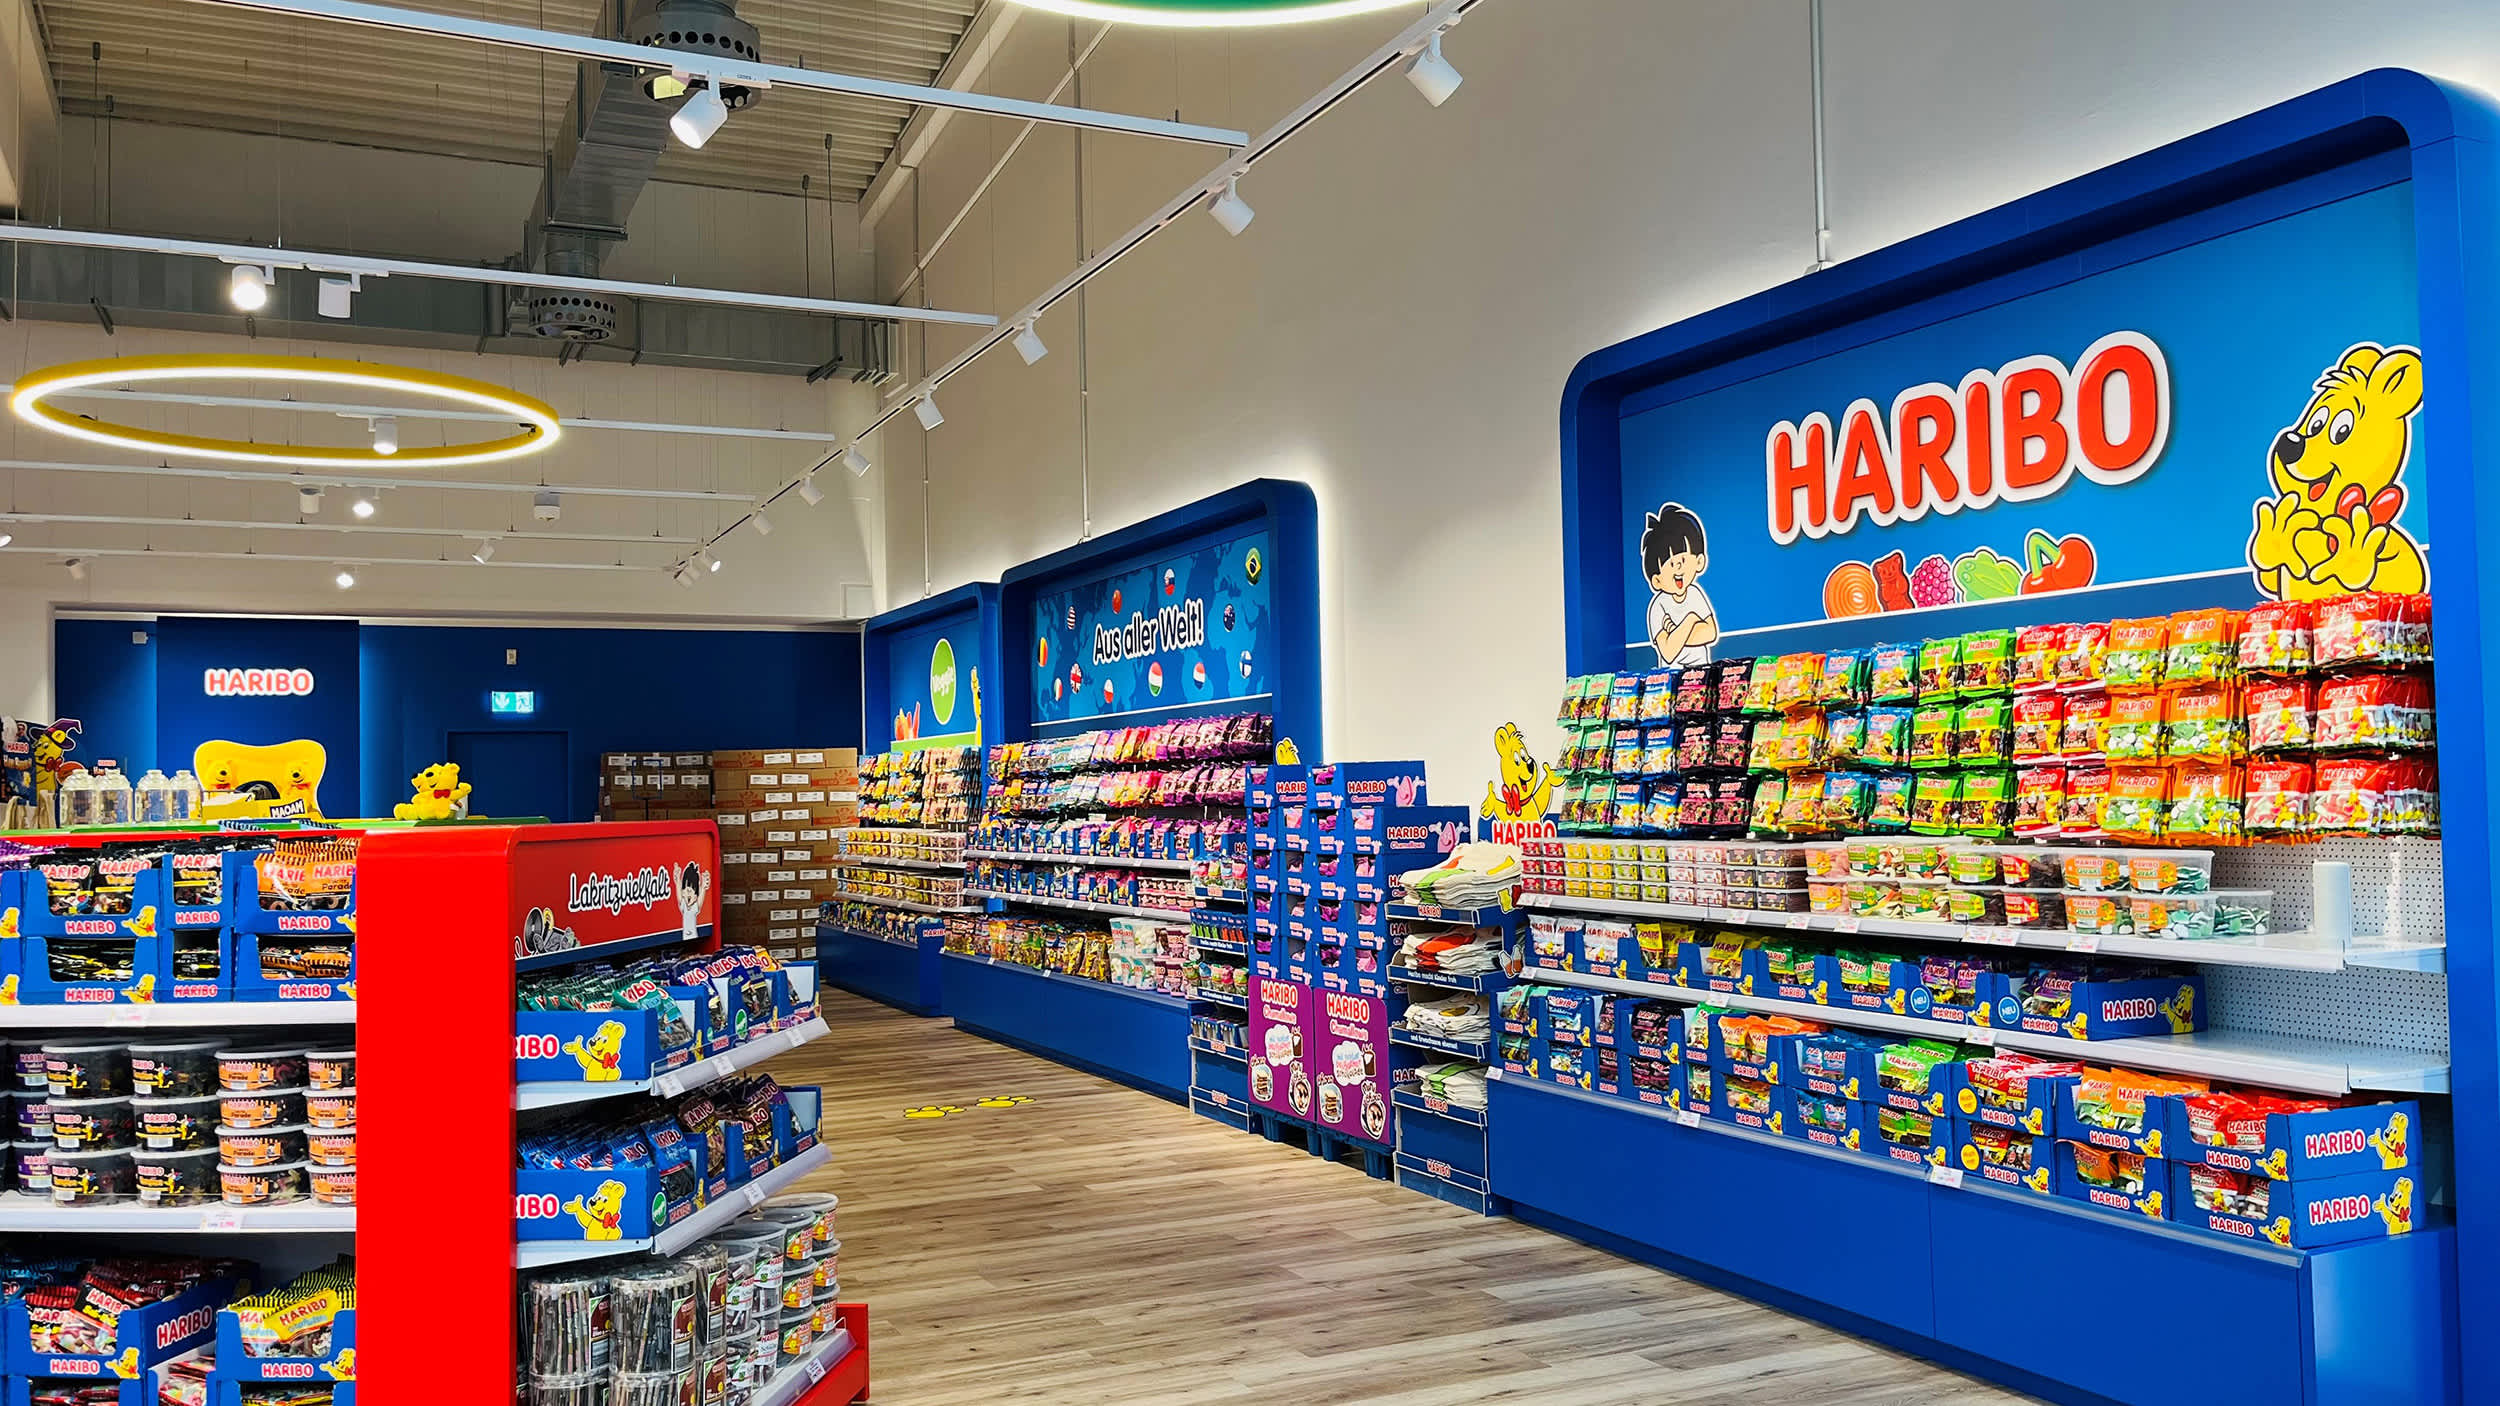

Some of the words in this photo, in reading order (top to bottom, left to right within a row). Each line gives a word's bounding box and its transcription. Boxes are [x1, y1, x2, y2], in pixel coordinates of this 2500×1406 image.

[1771, 340, 2162, 537] HARIBO
[1094, 624, 1121, 665] Aus
[1125, 612, 1159, 655] aller
[1160, 598, 1204, 651] Welt!
[1969, 639, 1999, 650] HARIBO
[207, 671, 312, 694] HARIBO
[2177, 694, 2219, 708] HARIBO
[2252, 687, 2294, 704] HARIBO
[2023, 774, 2058, 787] HARIBO
[2074, 774, 2110, 787] HARIBO
[2116, 774, 2157, 787] HARIBO
[2252, 768, 2292, 782] HARIBO
[1276, 781, 1307, 793] HARIB
[1348, 781, 1386, 793] HARIBO
[271, 801, 304, 818] MAOAM
[1387, 826, 1428, 839] HARIBO
[2074, 858, 2103, 866] HARIBO
[314, 862, 354, 879] HARIB
[569, 866, 670, 915] Lakritzvielfalt
[175, 911, 220, 924] HARIBO
[1418, 905, 1441, 917] HARIBO
[66, 921, 116, 934] HARIBO
[278, 917, 331, 930] HARIBO
[1648, 972, 1670, 983] HARIBO
[174, 984, 218, 998] HARIBO
[279, 984, 330, 999] HARIBO
[1710, 980, 1733, 992] HARIBO
[1779, 985, 1806, 999] HARIBO
[64, 988, 115, 1002] HARIBO
[1261, 980, 1298, 1008] HARIBO
[1852, 995, 1881, 1008] HARIBO
[1914, 996, 1927, 1005] NEU
[1327, 992, 1370, 1024] HARIBO
[1932, 1006, 1964, 1021] HARIBO
[2002, 1006, 2016, 1015] NEU
[2102, 998, 2157, 1022] HARIBO
[2022, 1017, 2059, 1032] HARIBO
[1686, 1050, 1708, 1062] HARIBO
[1824, 1051, 1846, 1061] HARIB
[1393, 1068, 1417, 1082] HAR
[1733, 1064, 1759, 1079] HARIBO
[1972, 1063, 2005, 1080] HARIBO
[1808, 1079, 1837, 1093] HARIBO
[1424, 1097, 1448, 1112] HARIBO
[1689, 1102, 1711, 1114] HARIBO
[1888, 1094, 1919, 1110] HARIBO
[1736, 1112, 1762, 1127] HARIBO
[1981, 1108, 2016, 1125] HARIBO
[1808, 1129, 1837, 1146] HARIBO
[2089, 1130, 2129, 1149] HARIBO
[2305, 1129, 2365, 1159] HARIBO
[1889, 1147, 1921, 1163] HARIBO
[2206, 1150, 2250, 1170] HARIBO
[1427, 1159, 1451, 1177] HARIBO
[1984, 1166, 2018, 1184] HARIBO
[2090, 1189, 2129, 1209] HARIBO
[2309, 1195, 2370, 1225] HARIBO
[2209, 1216, 2254, 1237] HARIBO
[87, 1288, 131, 1314] HARIBO
[280, 1298, 327, 1326] HARIBO
[157, 1305, 212, 1349] HARIBO
[51, 1359, 100, 1374] HARIBO
[262, 1363, 314, 1378] HARIBO
